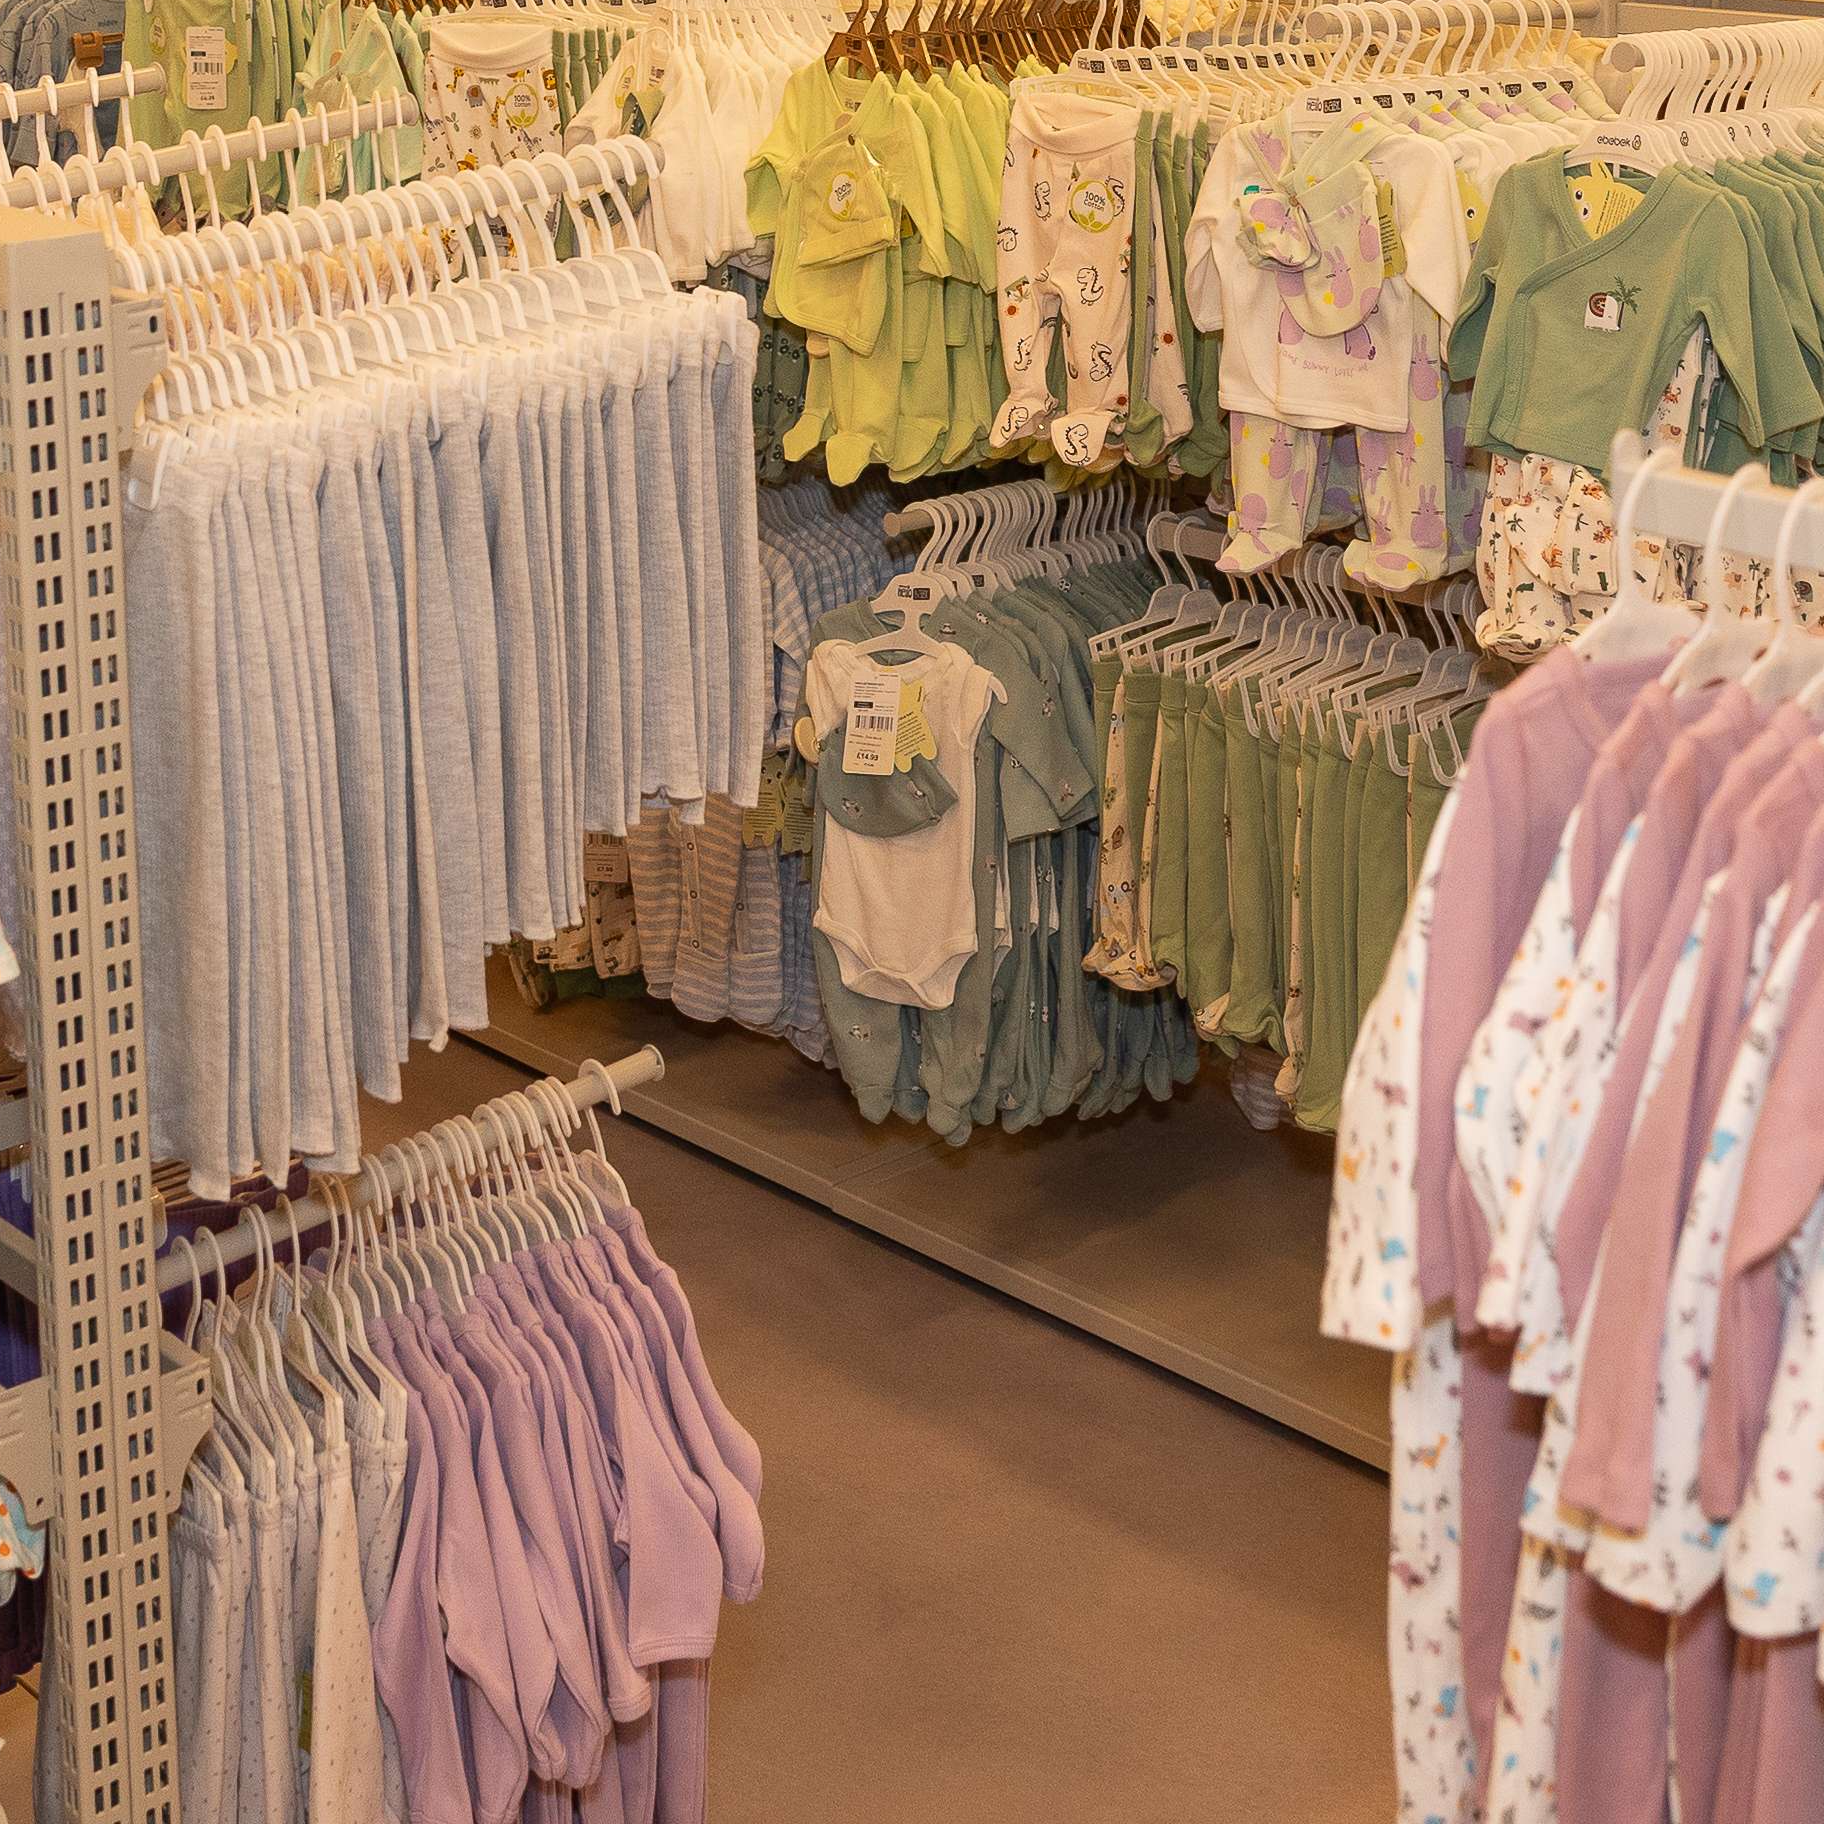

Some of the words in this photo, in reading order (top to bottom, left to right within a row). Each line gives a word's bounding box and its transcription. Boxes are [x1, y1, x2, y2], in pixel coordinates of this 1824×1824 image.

[1597, 135, 1631, 147] ebebek
[835, 182, 851, 196] 100%
[1084, 199, 1104, 211] Cotton
[1085, 191, 1106, 206] 100%
